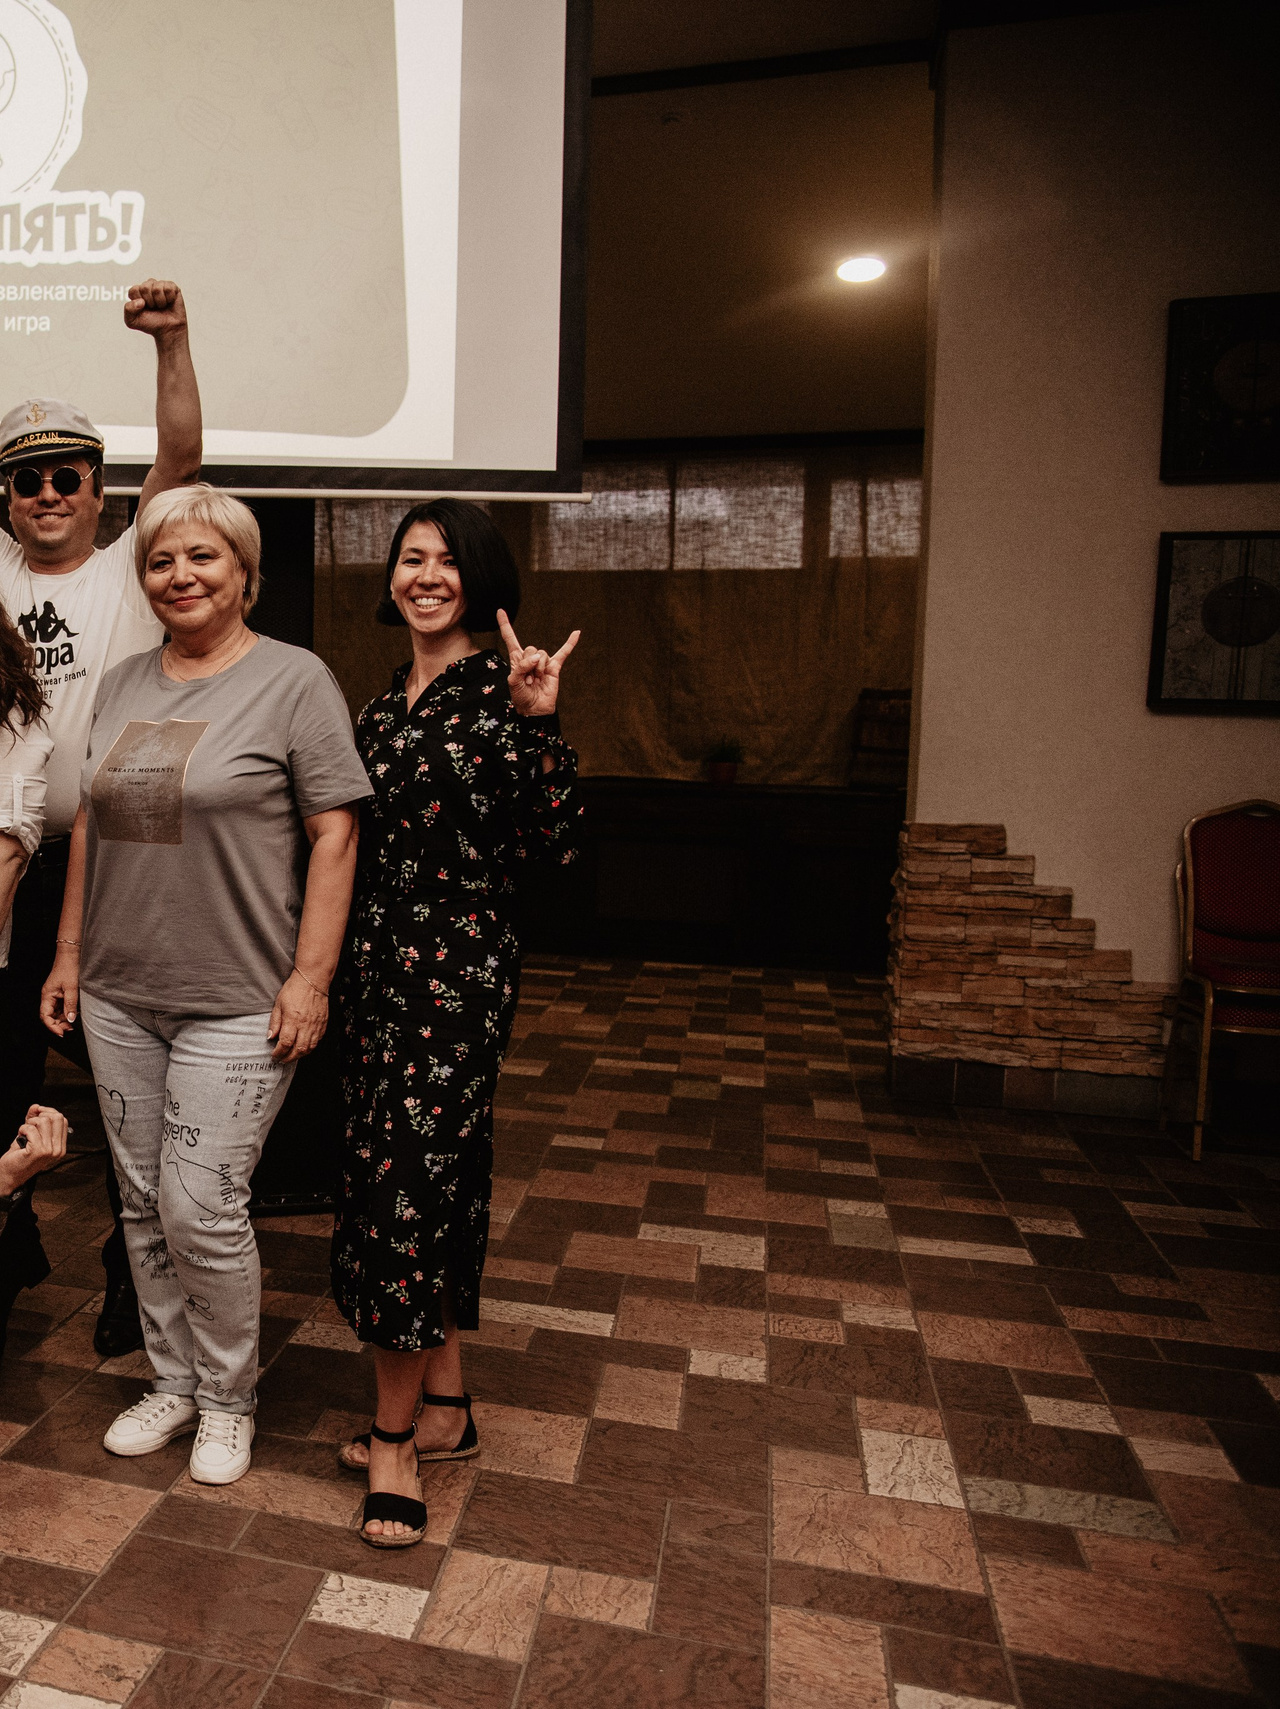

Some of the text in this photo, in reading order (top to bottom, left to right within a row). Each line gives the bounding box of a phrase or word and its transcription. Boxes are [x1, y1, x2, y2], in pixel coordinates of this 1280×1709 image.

[4, 313, 51, 335] игра
[16, 431, 59, 446] CAPTAIN
[35, 642, 75, 675] ppa
[43, 690, 53, 700] 67
[225, 1062, 278, 1072] EVERYTHING
